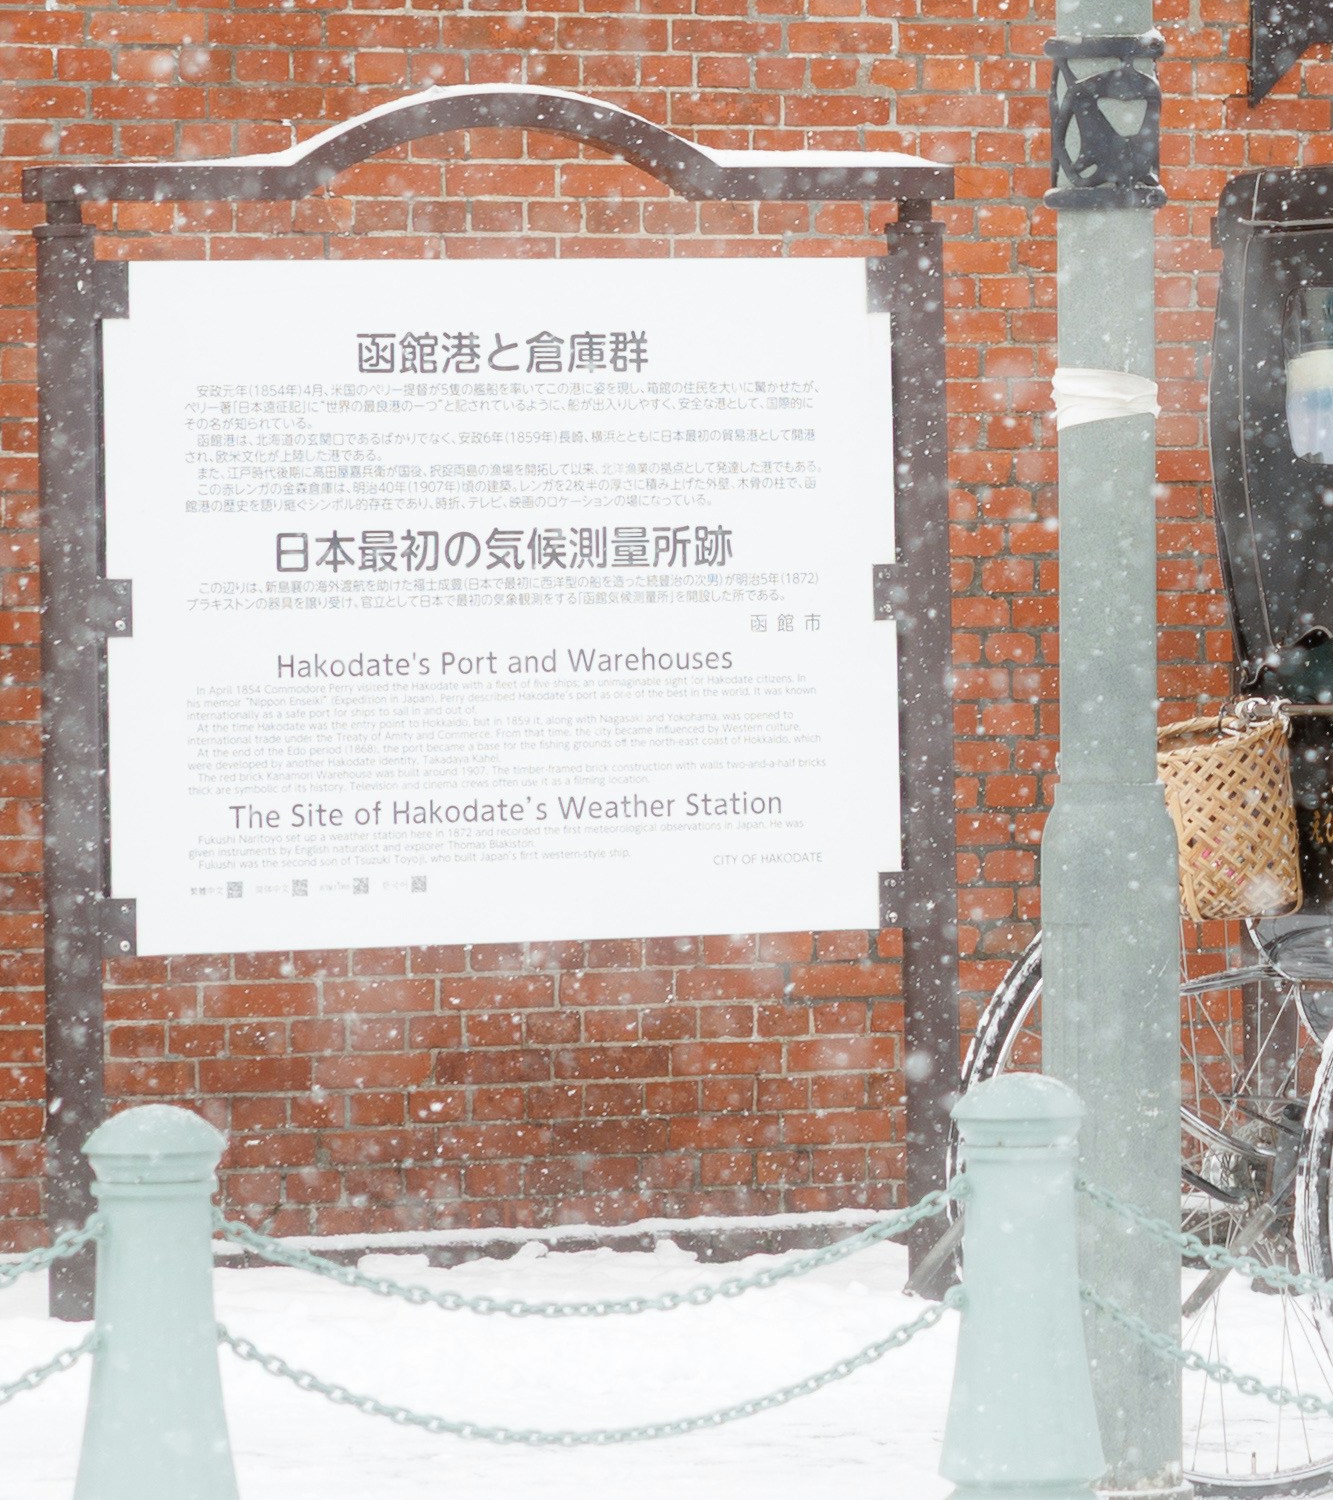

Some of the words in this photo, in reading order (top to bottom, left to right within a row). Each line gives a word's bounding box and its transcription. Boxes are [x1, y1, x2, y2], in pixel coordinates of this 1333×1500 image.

[356, 330, 649, 374] 函館港と倉庫群
[275, 524, 734, 573] 日本最初の気候測量所跡
[277, 650, 431, 679] Hakodate's
[441, 650, 498, 676] Port
[508, 648, 557, 675] and
[568, 646, 734, 673] Warehouses
[228, 803, 281, 830] The
[291, 801, 345, 828] Site
[355, 800, 385, 826] of
[392, 796, 548, 825] Hakodate's
[557, 792, 675, 821] Weather
[686, 789, 783, 817] Station
[713, 854, 737, 865] CITY
[741, 854, 756, 865] OF
[760, 852, 823, 864] HAKODATE
